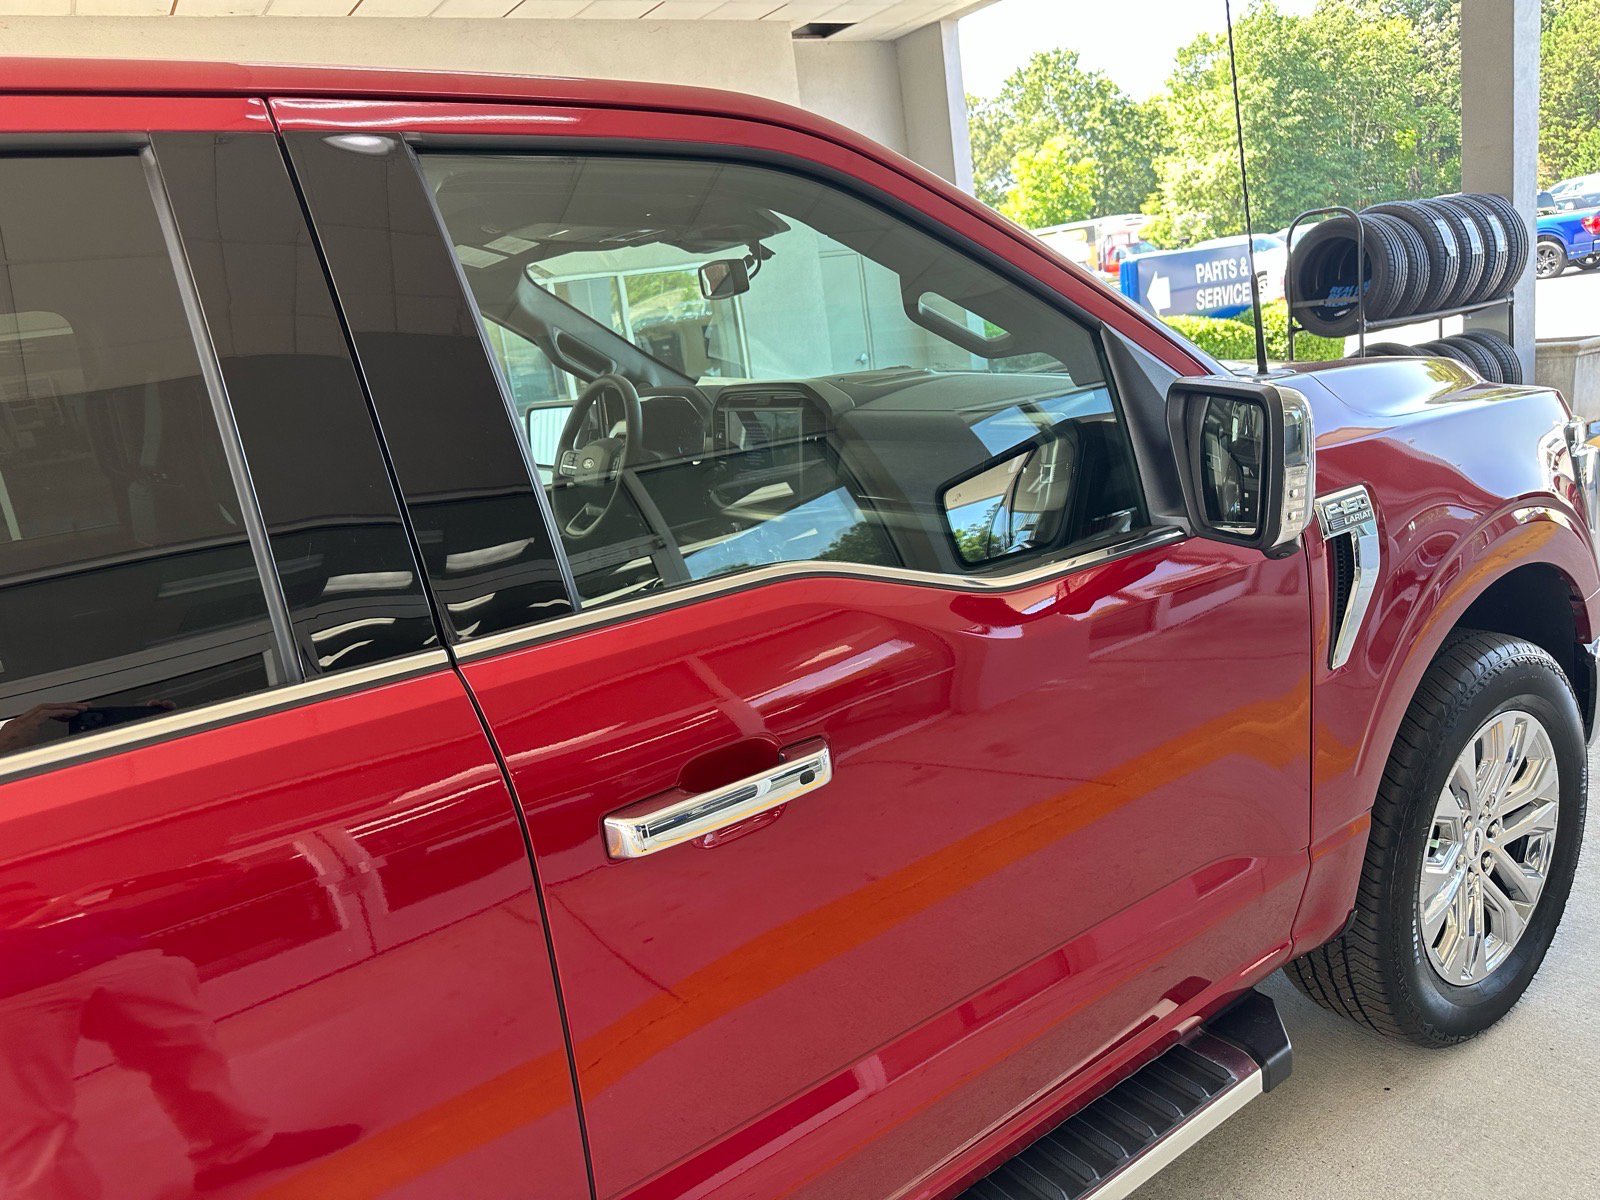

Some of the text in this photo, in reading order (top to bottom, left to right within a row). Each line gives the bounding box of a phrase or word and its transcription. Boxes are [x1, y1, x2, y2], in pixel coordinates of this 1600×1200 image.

[1195, 256, 1249, 284] PARTS &
[1196, 282, 1250, 311] SERVICE
[1344, 510, 1371, 525] LARIAT
